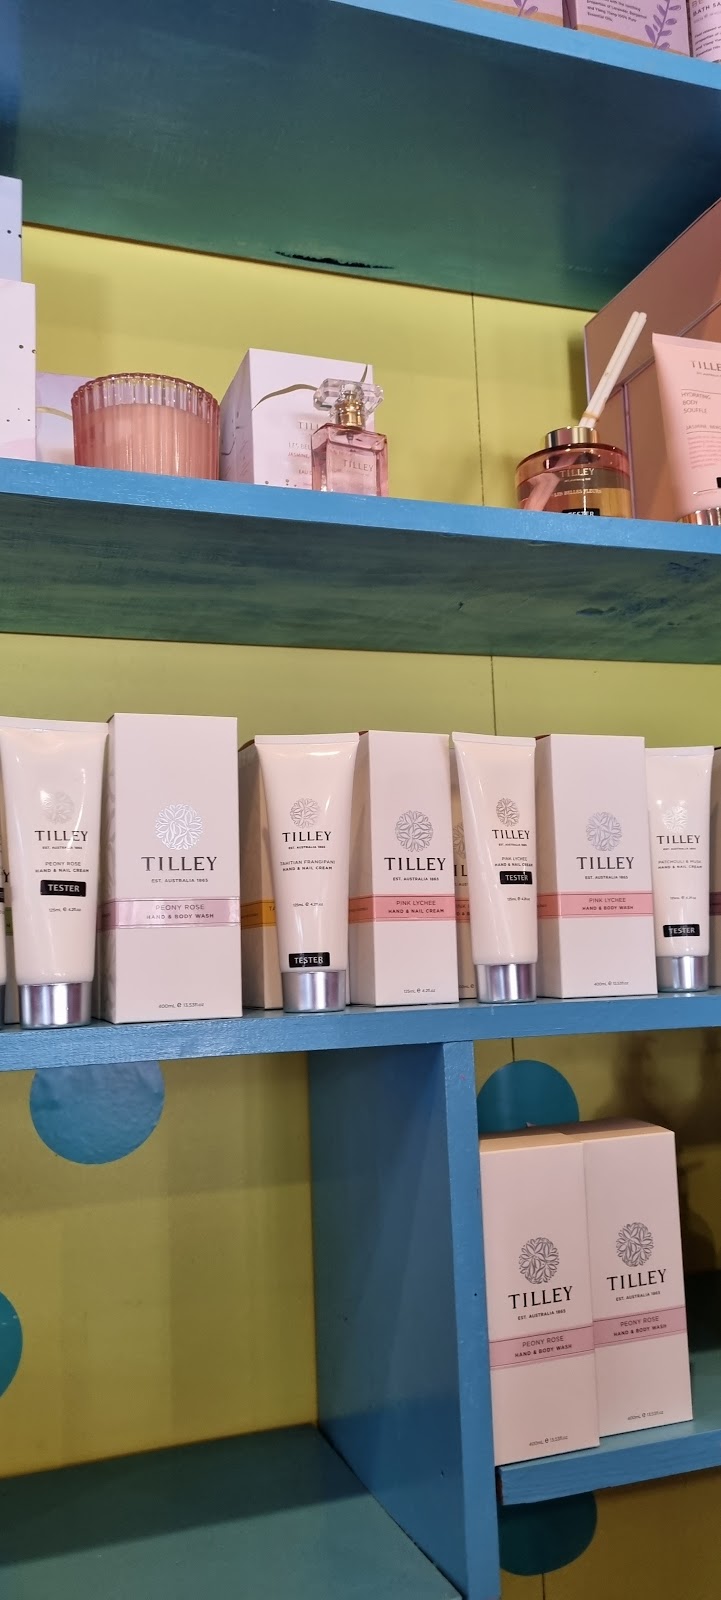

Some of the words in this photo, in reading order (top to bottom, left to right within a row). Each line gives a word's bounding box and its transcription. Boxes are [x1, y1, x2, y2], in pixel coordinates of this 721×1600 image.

[693, 5, 710, 17] BATH
[343, 460, 373, 472] TILLEY
[560, 468, 594, 478] TILLEY
[35, 831, 88, 841] TILLEY
[282, 831, 331, 842] TILLEY
[492, 830, 530, 840] TILLEY
[656, 835, 700, 844] TILLEY
[141, 856, 217, 871] TILLEY
[384, 858, 446, 871] TILLEY
[576, 857, 634, 870] TILLEY
[48, 884, 80, 892] TESTER
[606, 1269, 666, 1291] TILLEY
[508, 1286, 573, 1309] TILLEY
[529, 1311, 554, 1319] AUSTRALIA
